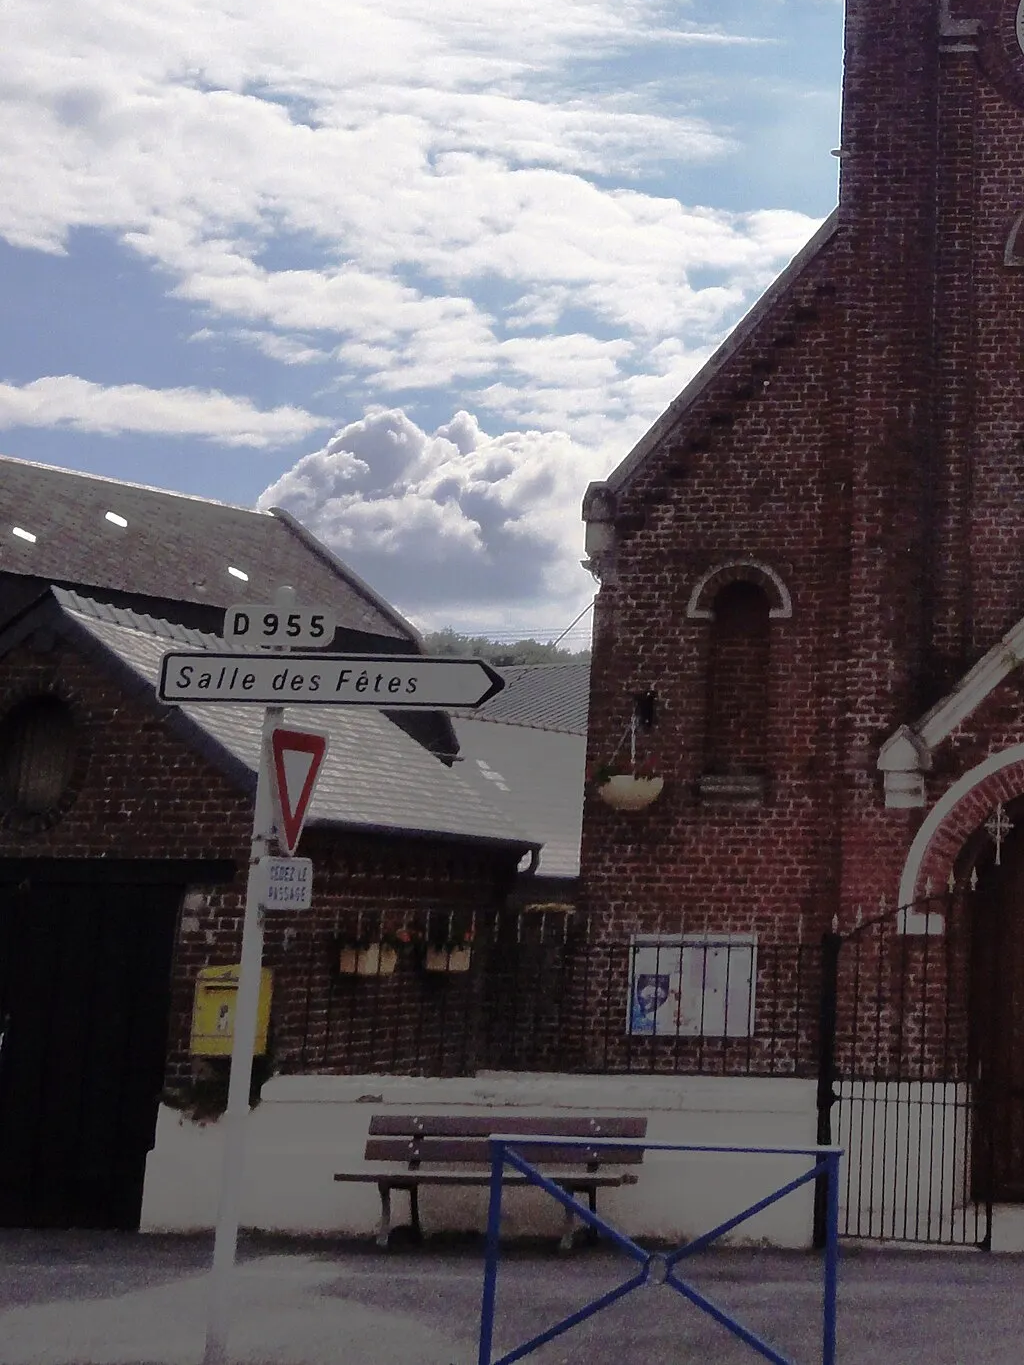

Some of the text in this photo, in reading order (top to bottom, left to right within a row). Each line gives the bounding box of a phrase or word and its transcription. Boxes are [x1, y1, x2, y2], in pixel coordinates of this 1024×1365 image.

[233, 612, 325, 637] D 955
[176, 666, 418, 694] Salle des Fêtes
[268, 885, 306, 902] PASSAGE
